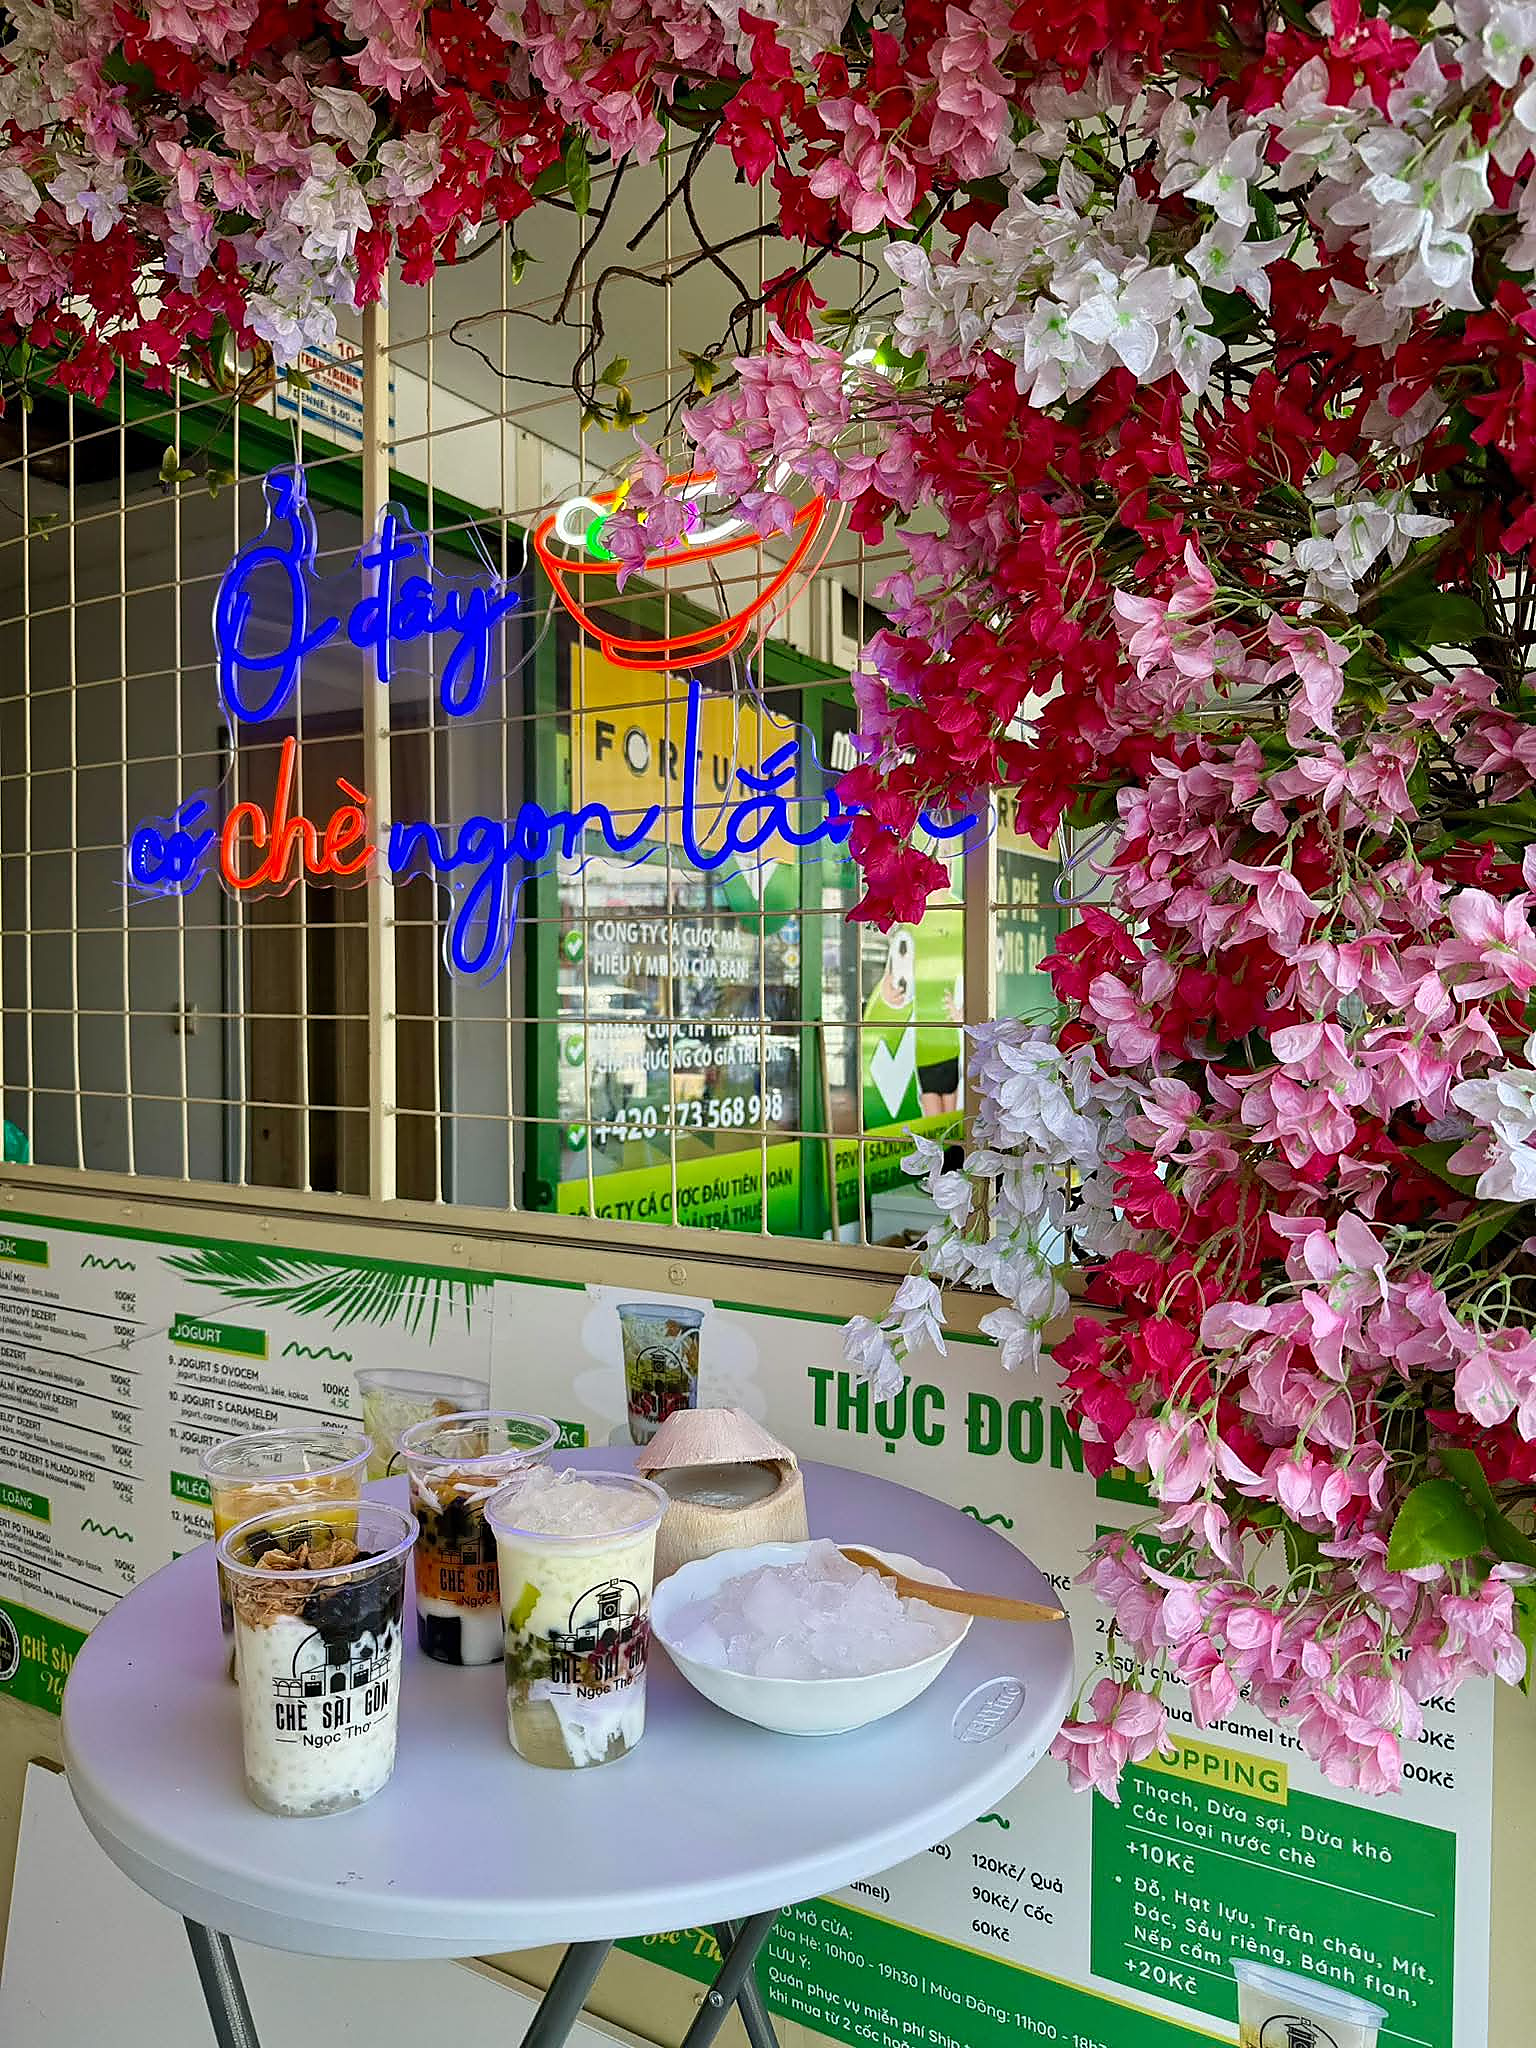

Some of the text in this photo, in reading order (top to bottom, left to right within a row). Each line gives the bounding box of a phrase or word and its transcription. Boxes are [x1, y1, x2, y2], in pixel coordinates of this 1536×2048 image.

[347, 513, 521, 718] đây
[221, 735, 377, 892] chè
[388, 797, 661, 975] ngon
[708, 1096, 746, 1128] 568
[174, 1323, 222, 1344] JOGURT
[178, 1357, 212, 1372] JOGURT
[221, 1364, 259, 1380] OVOCEM
[181, 1393, 215, 1409] JOGURT
[224, 1402, 279, 1424] CARAMELEM
[321, 1382, 350, 1398] 100Kč
[180, 1430, 213, 1447] JOGURT
[807, 1367, 1084, 1474] THỰC ĐƠN
[22, 1634, 49, 1666] CHÈ
[275, 1678, 389, 1732] CHÈ SÀI GÒN
[303, 1721, 372, 1749] Ngọc Thơ
[1159, 1750, 1280, 1794] OPPING
[1132, 1803, 1317, 1870] Các loại nước chè
[1133, 1778, 1393, 1863] Thạch, Dừa sợi, Dừa khô
[971, 1853, 1064, 1894] 120Kč/ Quả
[1125, 1840, 1196, 1875] +10Kč
[971, 1886, 1019, 1913] 90Kč/
[1023, 1903, 1054, 1925] Cốc
[795, 1910, 818, 1928] MỞ
[820, 1917, 853, 1941] CỬA:
[971, 1919, 1011, 1943] 60Kč
[1133, 1923, 1172, 1952] Nếp
[1174, 1888, 1211, 1915] Hạt
[1218, 1901, 1256, 1929] lựu,
[1264, 1915, 1315, 1946] Trân
[1323, 1934, 1383, 1970] châu,
[1392, 1954, 1435, 1986] Mít,
[768, 1943, 812, 1972] LƯU Ý:
[1133, 1901, 1418, 2008] Đác, Sầu riêng, Bánh flan,
[799, 1932, 821, 1952] Hè:
[824, 1942, 865, 1969] 10h00
[878, 1962, 919, 1989] 19h30
[930, 1980, 962, 2005] Mùa
[966, 1994, 1010, 2025] Đông:
[1014, 2012, 1058, 2041] 11h00
[1124, 1958, 1198, 1996] +20Kč
[768, 1965, 804, 1991] Quán
[807, 1982, 841, 2006] phục
[843, 1997, 861, 2015] vụ
[864, 2003, 899, 2029] miễn
[903, 2019, 925, 2039] phí
[769, 1986, 880, 2043] khi mua từ 2 cốc
